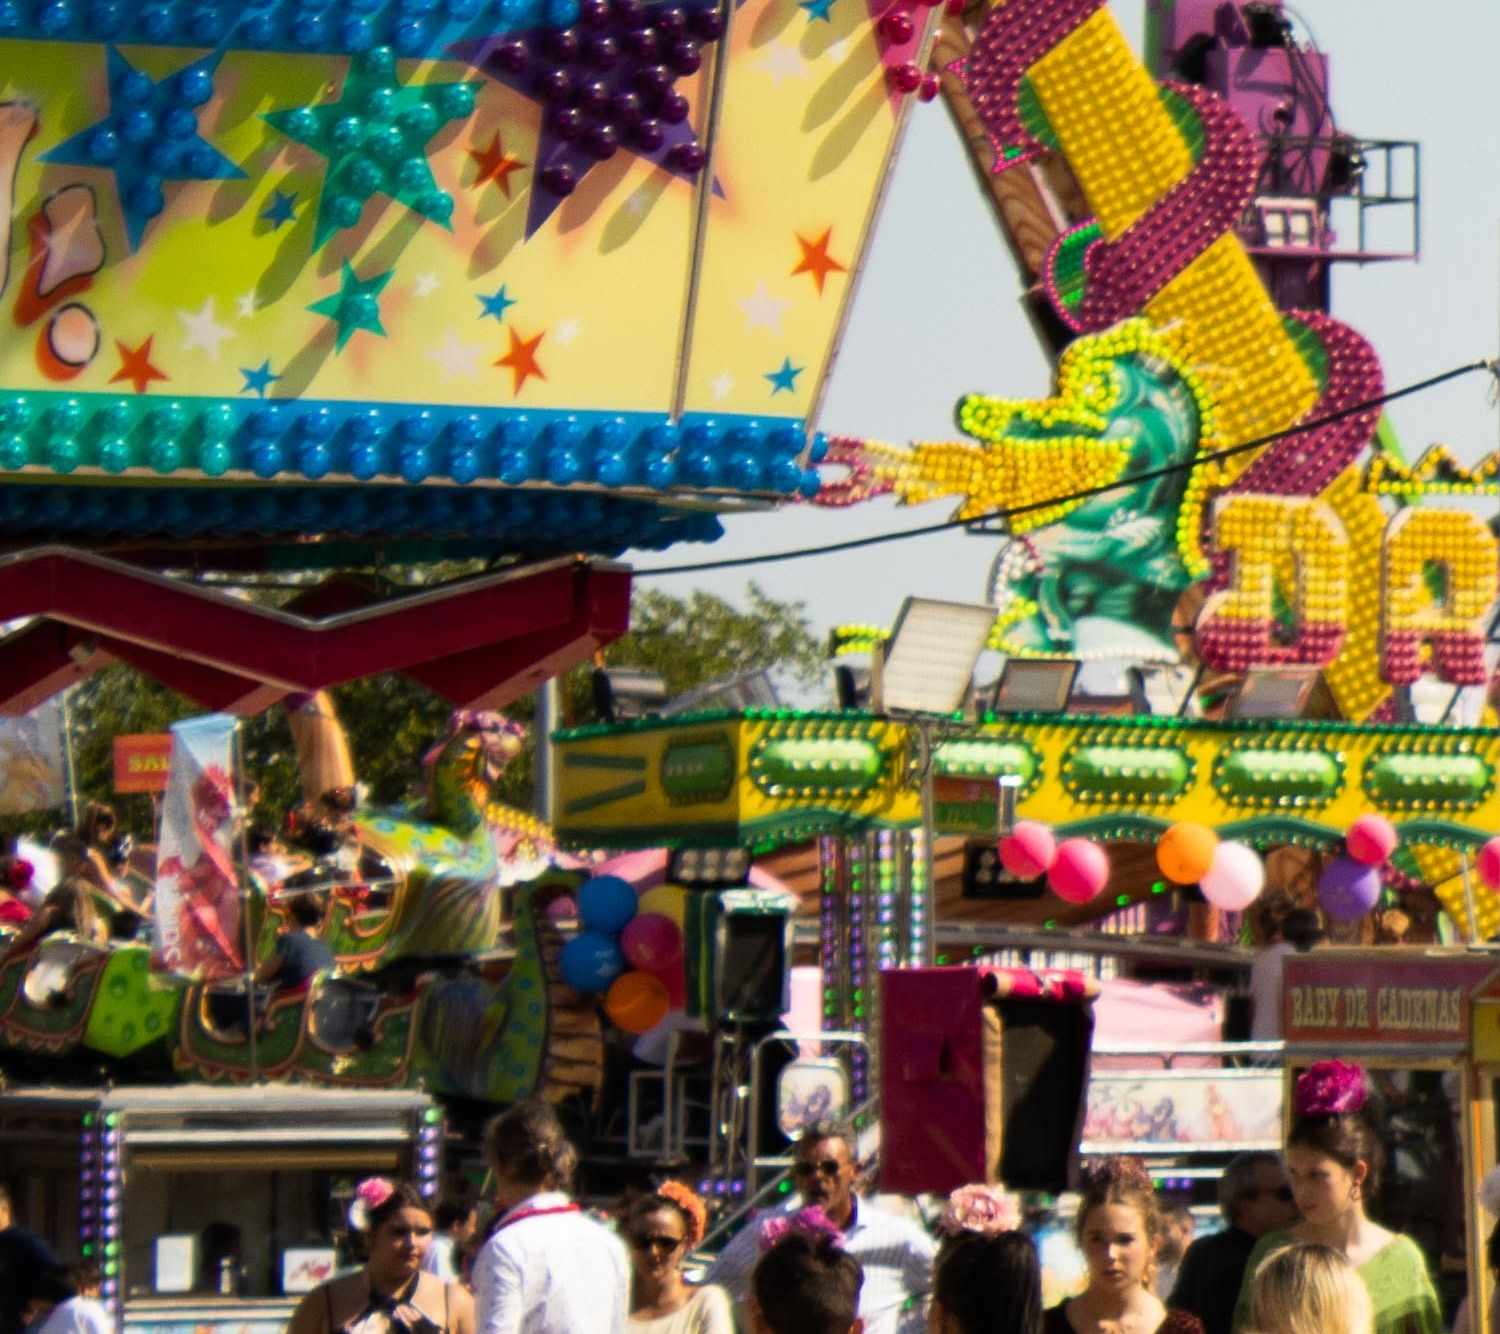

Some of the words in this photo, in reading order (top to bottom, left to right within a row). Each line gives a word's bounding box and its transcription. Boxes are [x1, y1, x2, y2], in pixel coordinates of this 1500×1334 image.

[1292, 987, 1340, 1028] BABY
[1343, 987, 1370, 1029] DE
[1376, 988, 1462, 1033] CADENAS
